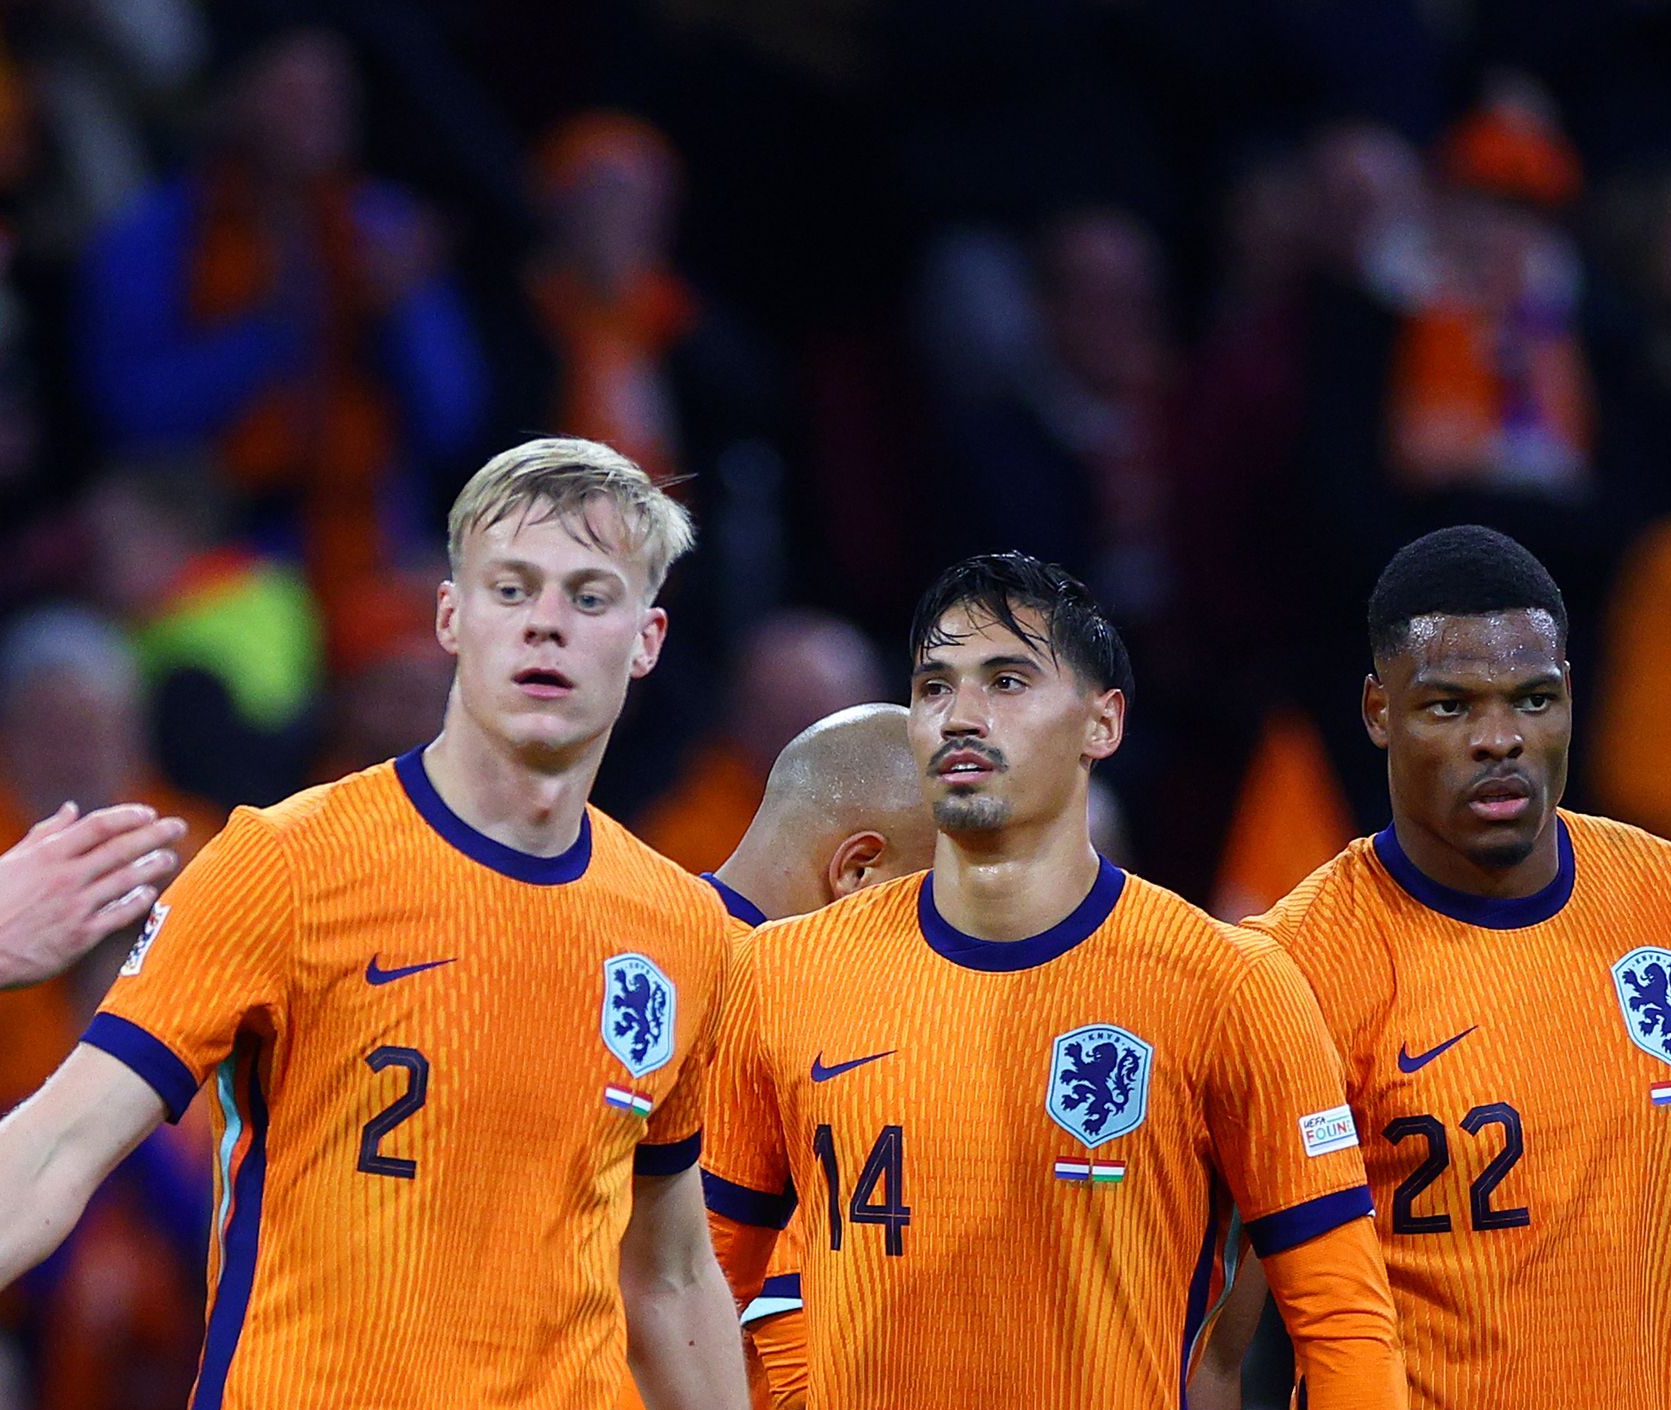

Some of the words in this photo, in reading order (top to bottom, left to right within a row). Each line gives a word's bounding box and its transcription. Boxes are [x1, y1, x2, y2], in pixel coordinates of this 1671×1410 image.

[357, 1045, 429, 1180] 2
[1303, 1116, 1326, 1129] UEFA
[1381, 1102, 1530, 1234] 22
[813, 1124, 911, 1256] 14
